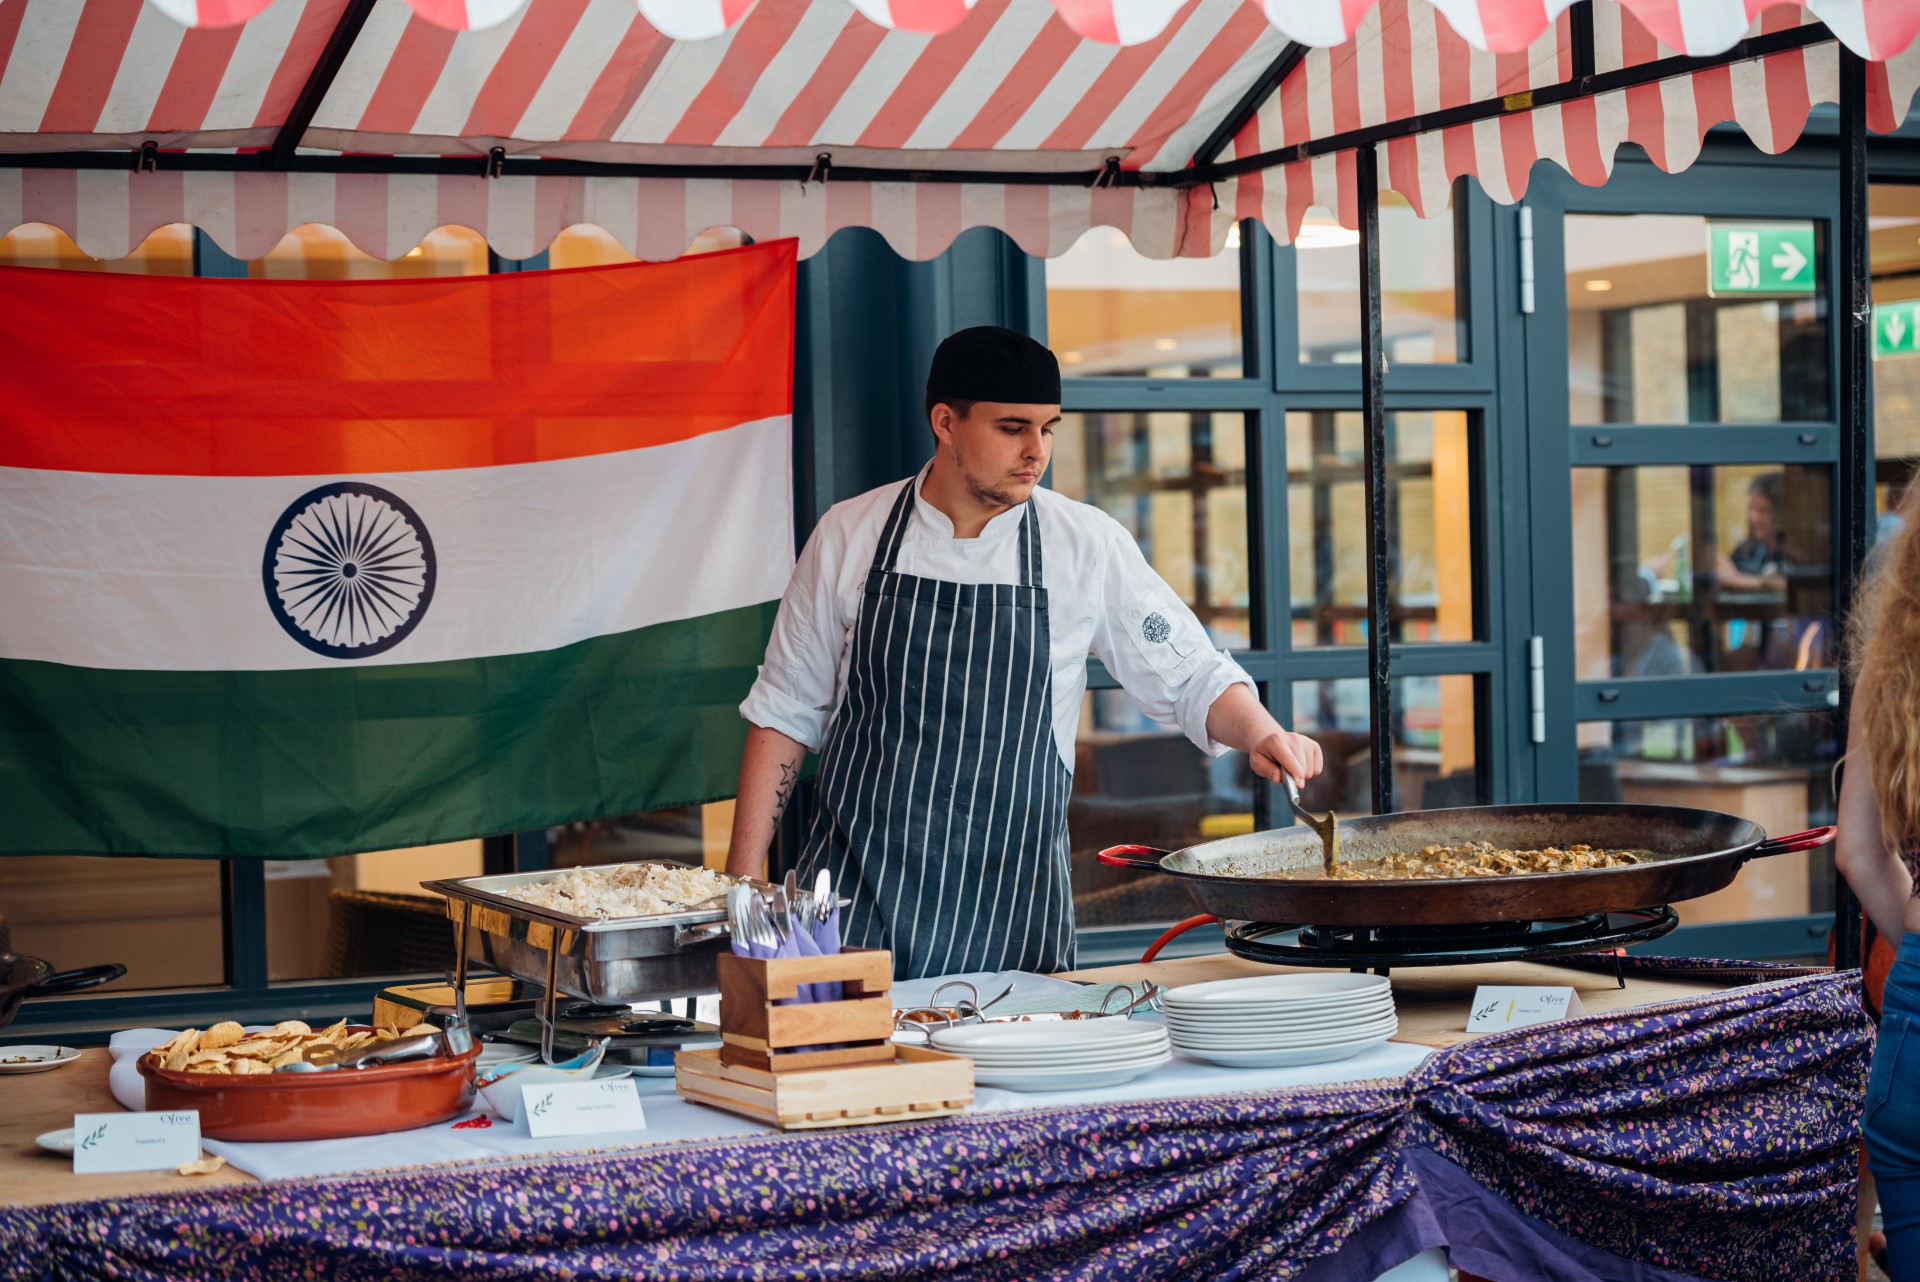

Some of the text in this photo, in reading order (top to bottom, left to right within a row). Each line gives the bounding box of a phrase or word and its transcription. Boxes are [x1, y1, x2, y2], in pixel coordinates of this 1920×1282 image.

[1540, 994, 1564, 1004] Olive
[600, 1081, 629, 1093] Olive
[160, 1112, 191, 1125] Olive
